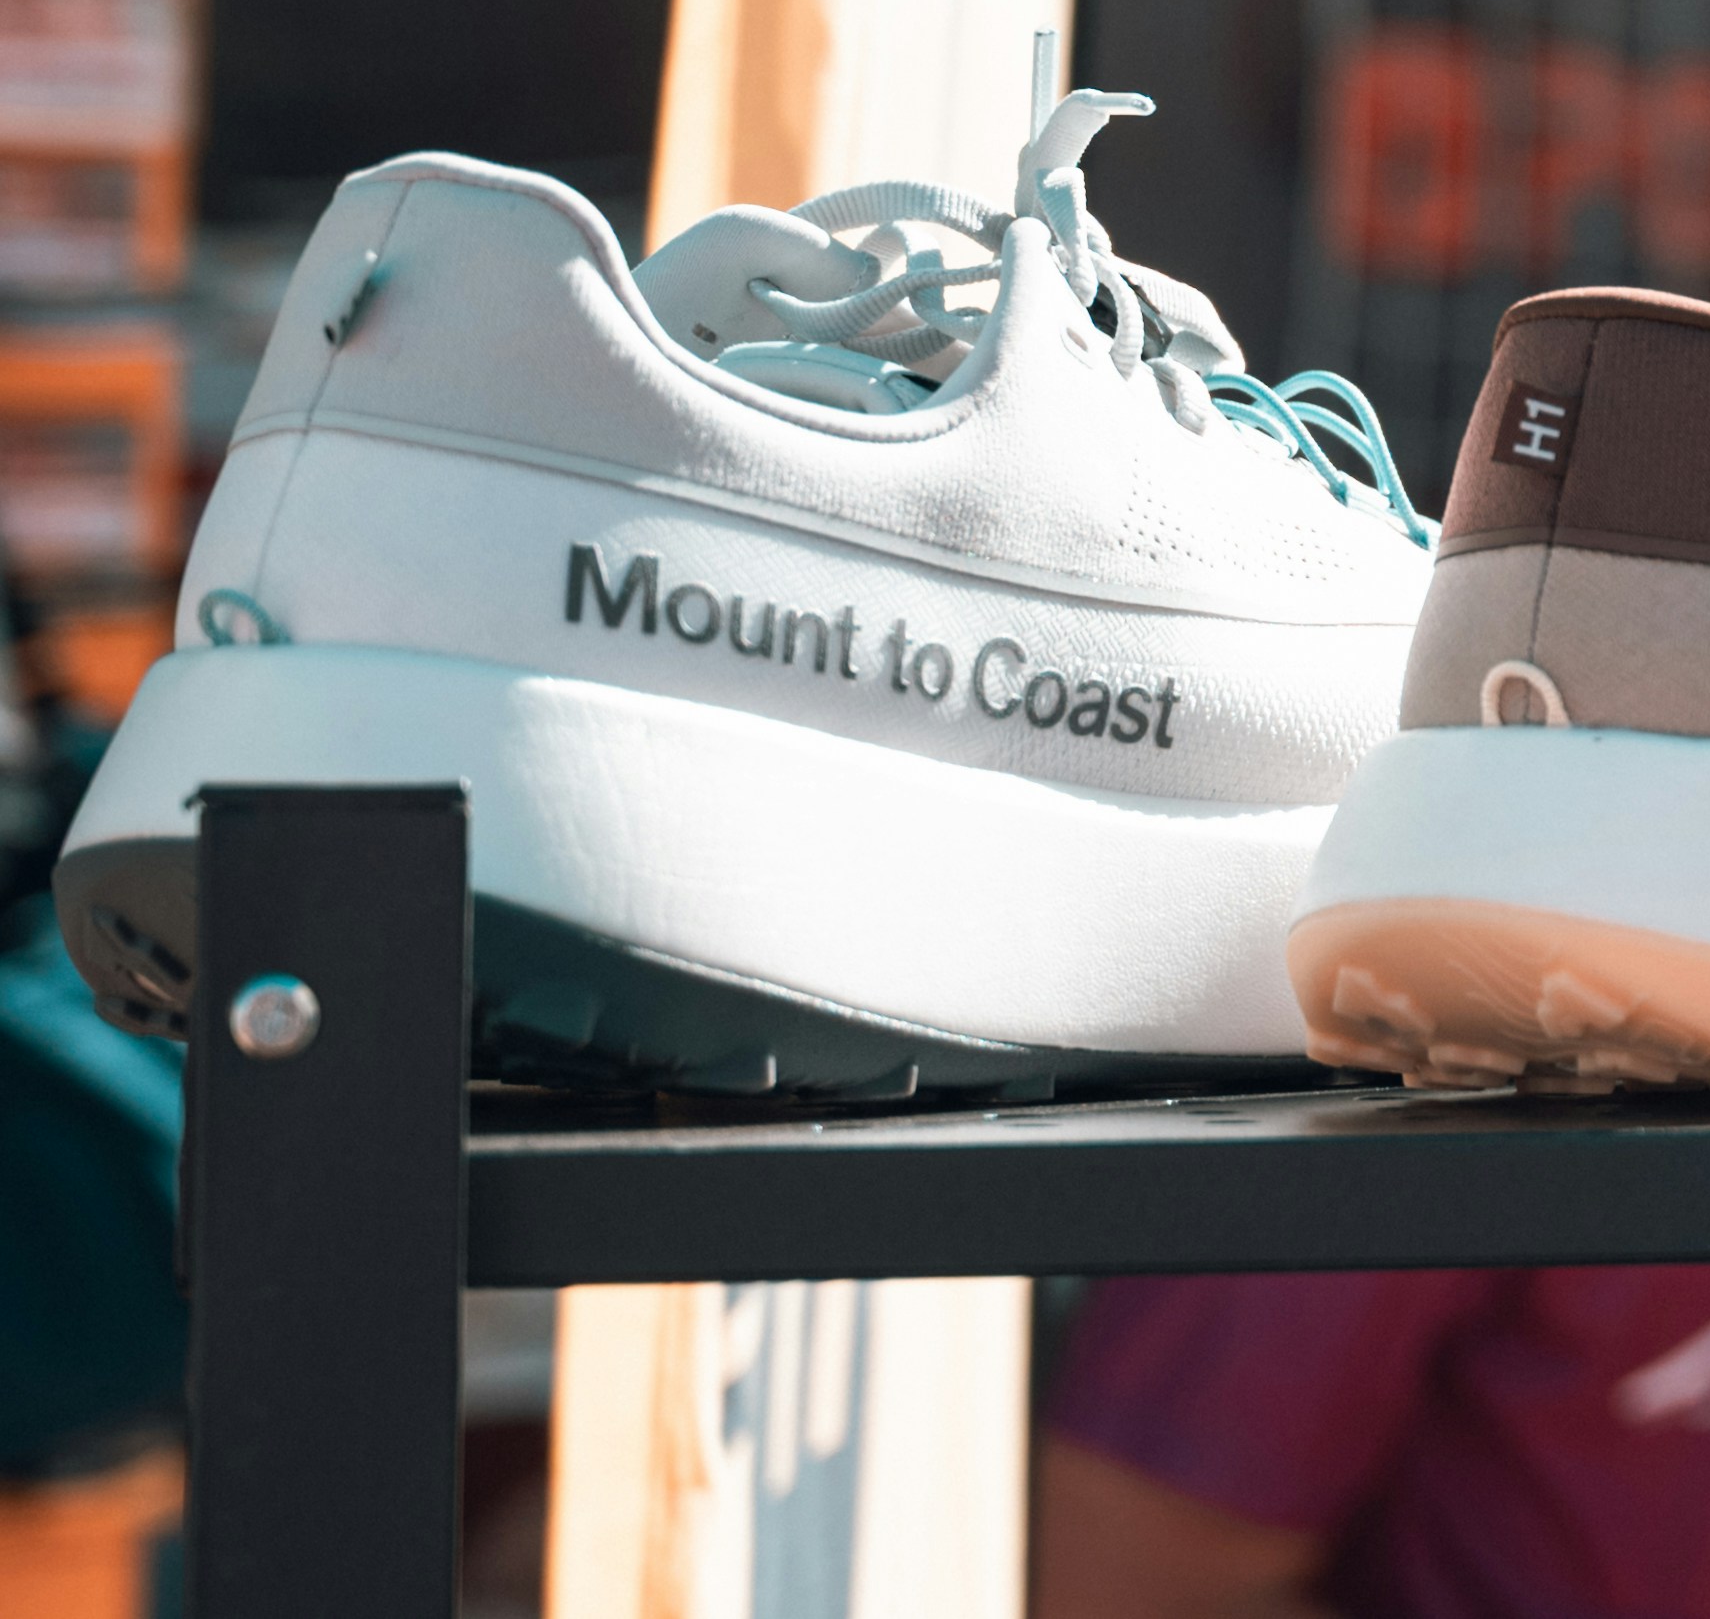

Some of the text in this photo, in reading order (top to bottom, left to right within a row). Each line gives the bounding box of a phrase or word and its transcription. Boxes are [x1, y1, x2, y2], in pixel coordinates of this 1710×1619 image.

[1513, 398, 1565, 462] H1
[565, 541, 1181, 748] Mount to Coast
